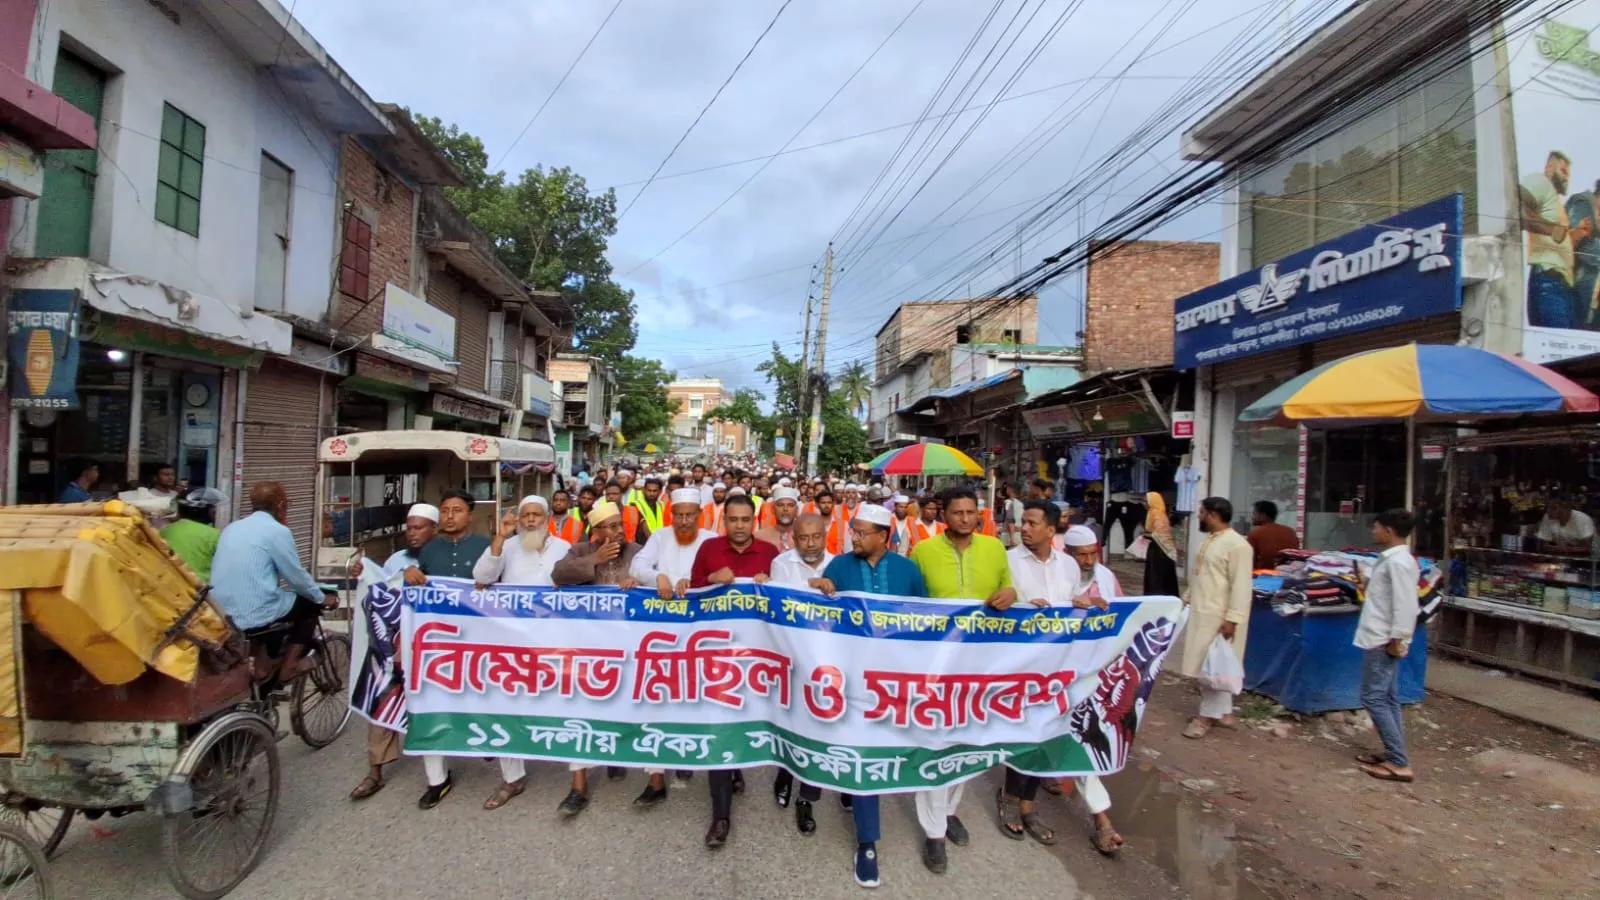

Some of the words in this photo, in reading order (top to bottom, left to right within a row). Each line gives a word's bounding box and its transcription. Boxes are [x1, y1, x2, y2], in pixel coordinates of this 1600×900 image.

[470, 588, 537, 610] গণরায়
[781, 598, 844, 624] সুশাসন
[849, 608, 864, 626] ও
[869, 609, 950, 633] জনগণের
[953, 611, 1017, 634] অধিকার
[409, 620, 626, 698] বিক্ষোভ
[631, 628, 792, 709] মিছিল
[804, 664, 847, 722] ও
[862, 669, 1077, 730] সমাবেশ
[466, 722, 511, 748] ১১
[529, 719, 622, 755] দলীয়
[744, 730, 909, 784] সাতক্ষীরা
[917, 748, 1014, 781] জেলা
